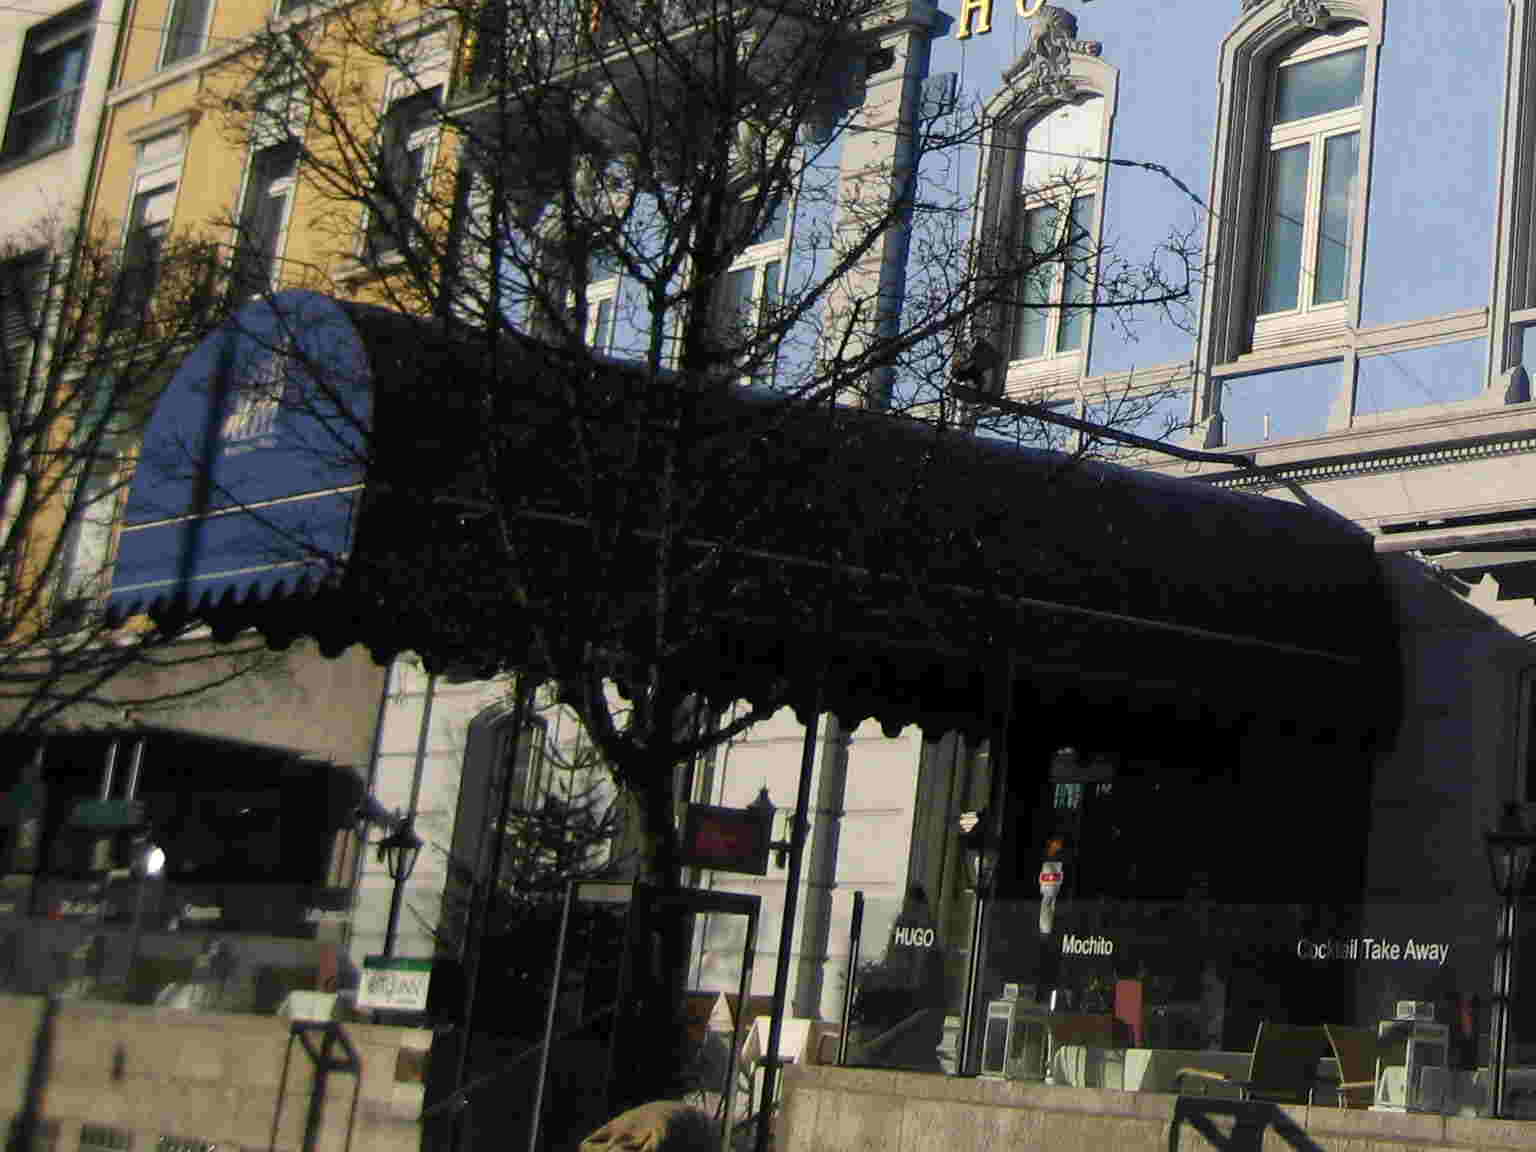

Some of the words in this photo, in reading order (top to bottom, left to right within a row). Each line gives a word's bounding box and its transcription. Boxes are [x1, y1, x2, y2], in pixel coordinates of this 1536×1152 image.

[894, 925, 935, 949] HUGO
[1061, 932, 1114, 956] Mochito
[1296, 937, 1358, 961] Cockail
[1362, 937, 1401, 961] Take
[1402, 937, 1450, 968] Away
